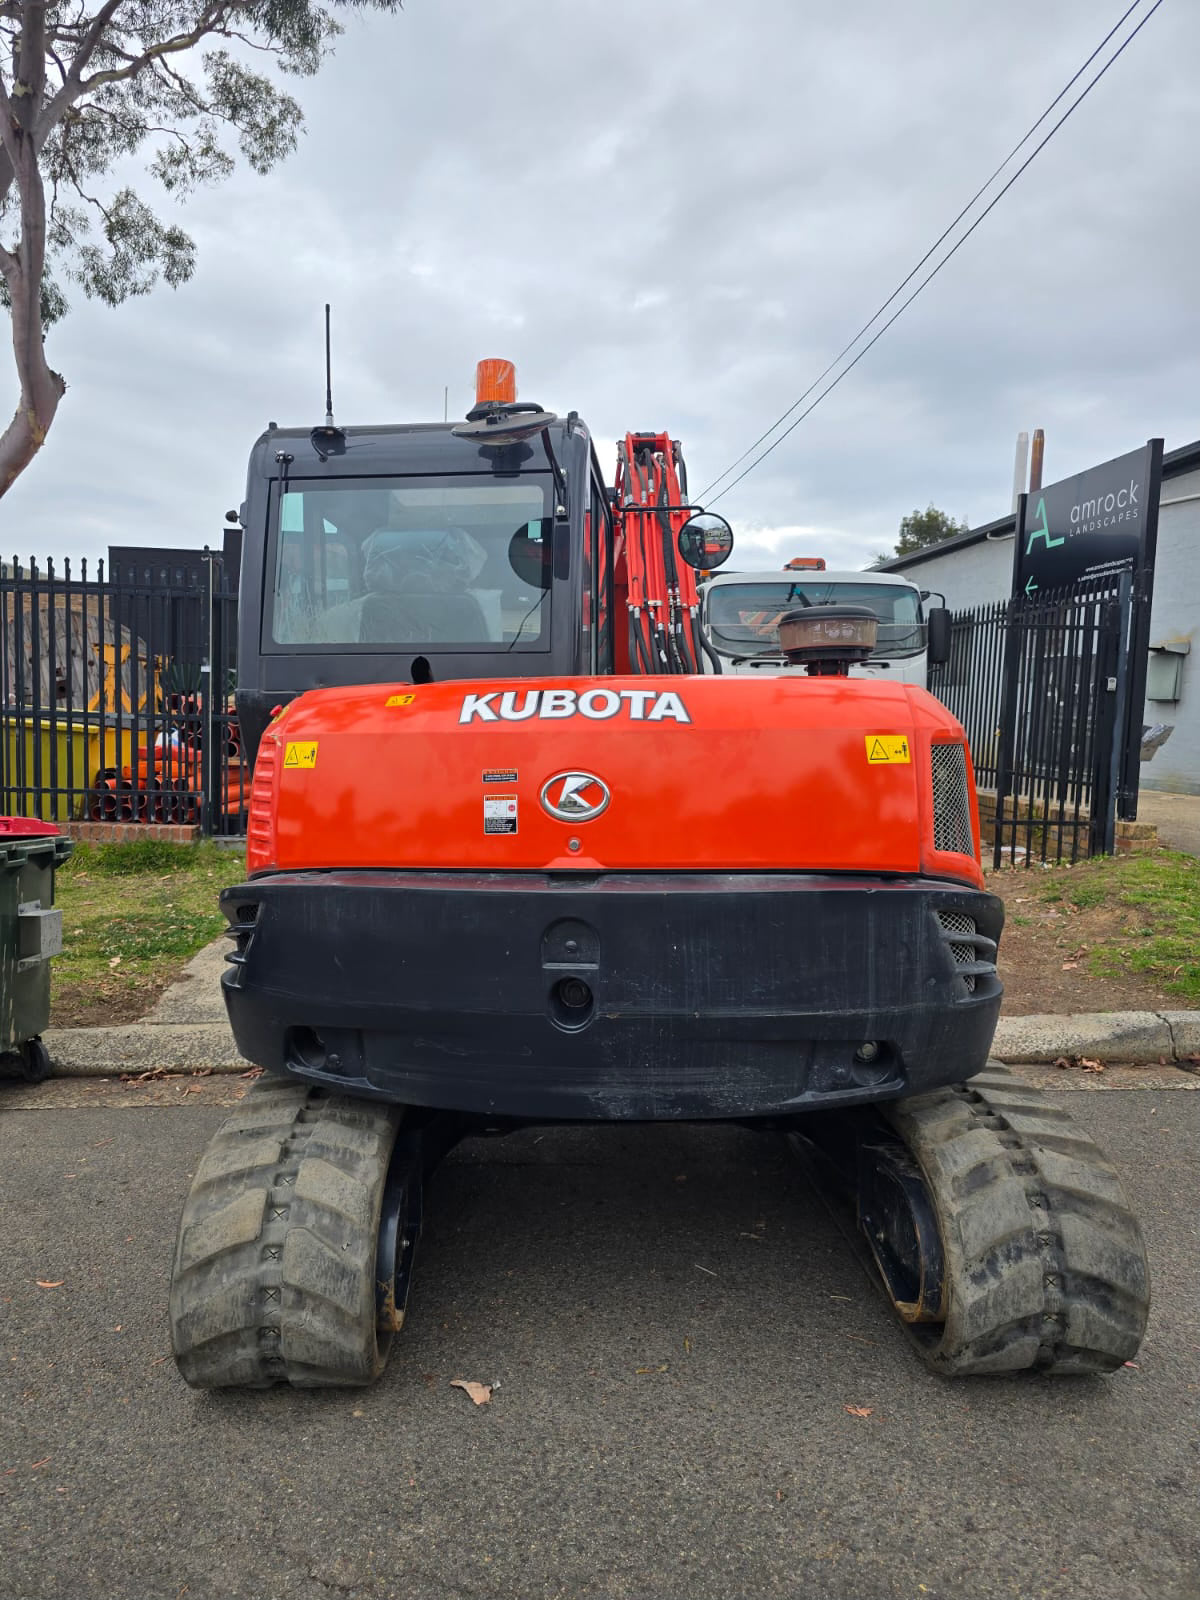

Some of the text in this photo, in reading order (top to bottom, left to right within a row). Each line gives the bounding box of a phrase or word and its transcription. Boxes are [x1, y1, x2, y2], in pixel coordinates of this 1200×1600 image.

[1070, 479, 1139, 524] amrock
[1069, 508, 1138, 537] LANDSCAPES
[459, 689, 691, 724] KUBOTA
